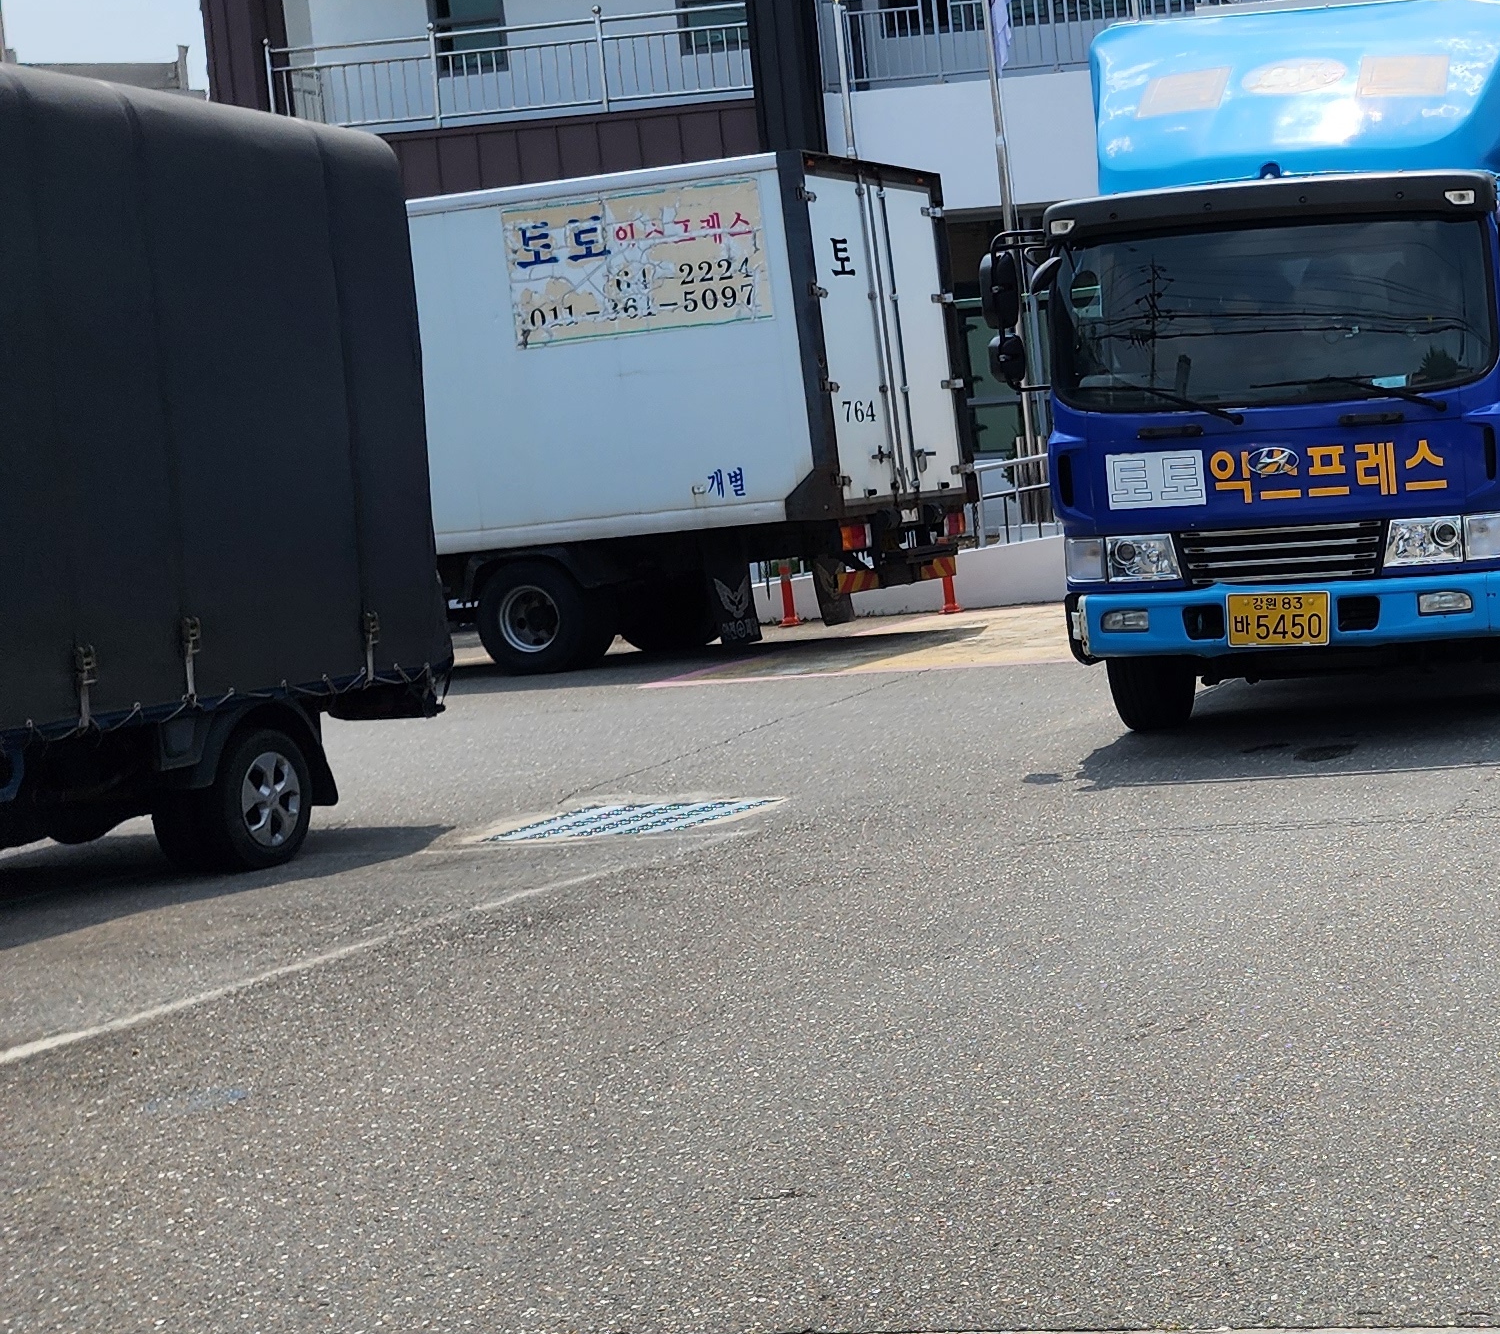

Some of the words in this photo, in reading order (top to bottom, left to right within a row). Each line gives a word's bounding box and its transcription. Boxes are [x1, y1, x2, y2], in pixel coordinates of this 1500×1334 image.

[830, 237, 856, 277] 토
[842, 400, 876, 424] 764
[707, 467, 746, 499] 개별
[1111, 455, 1203, 503] 토토
[1210, 439, 1447, 504] 익스프레스
[1252, 598, 1277, 611] 강원
[1281, 596, 1304, 611] 83
